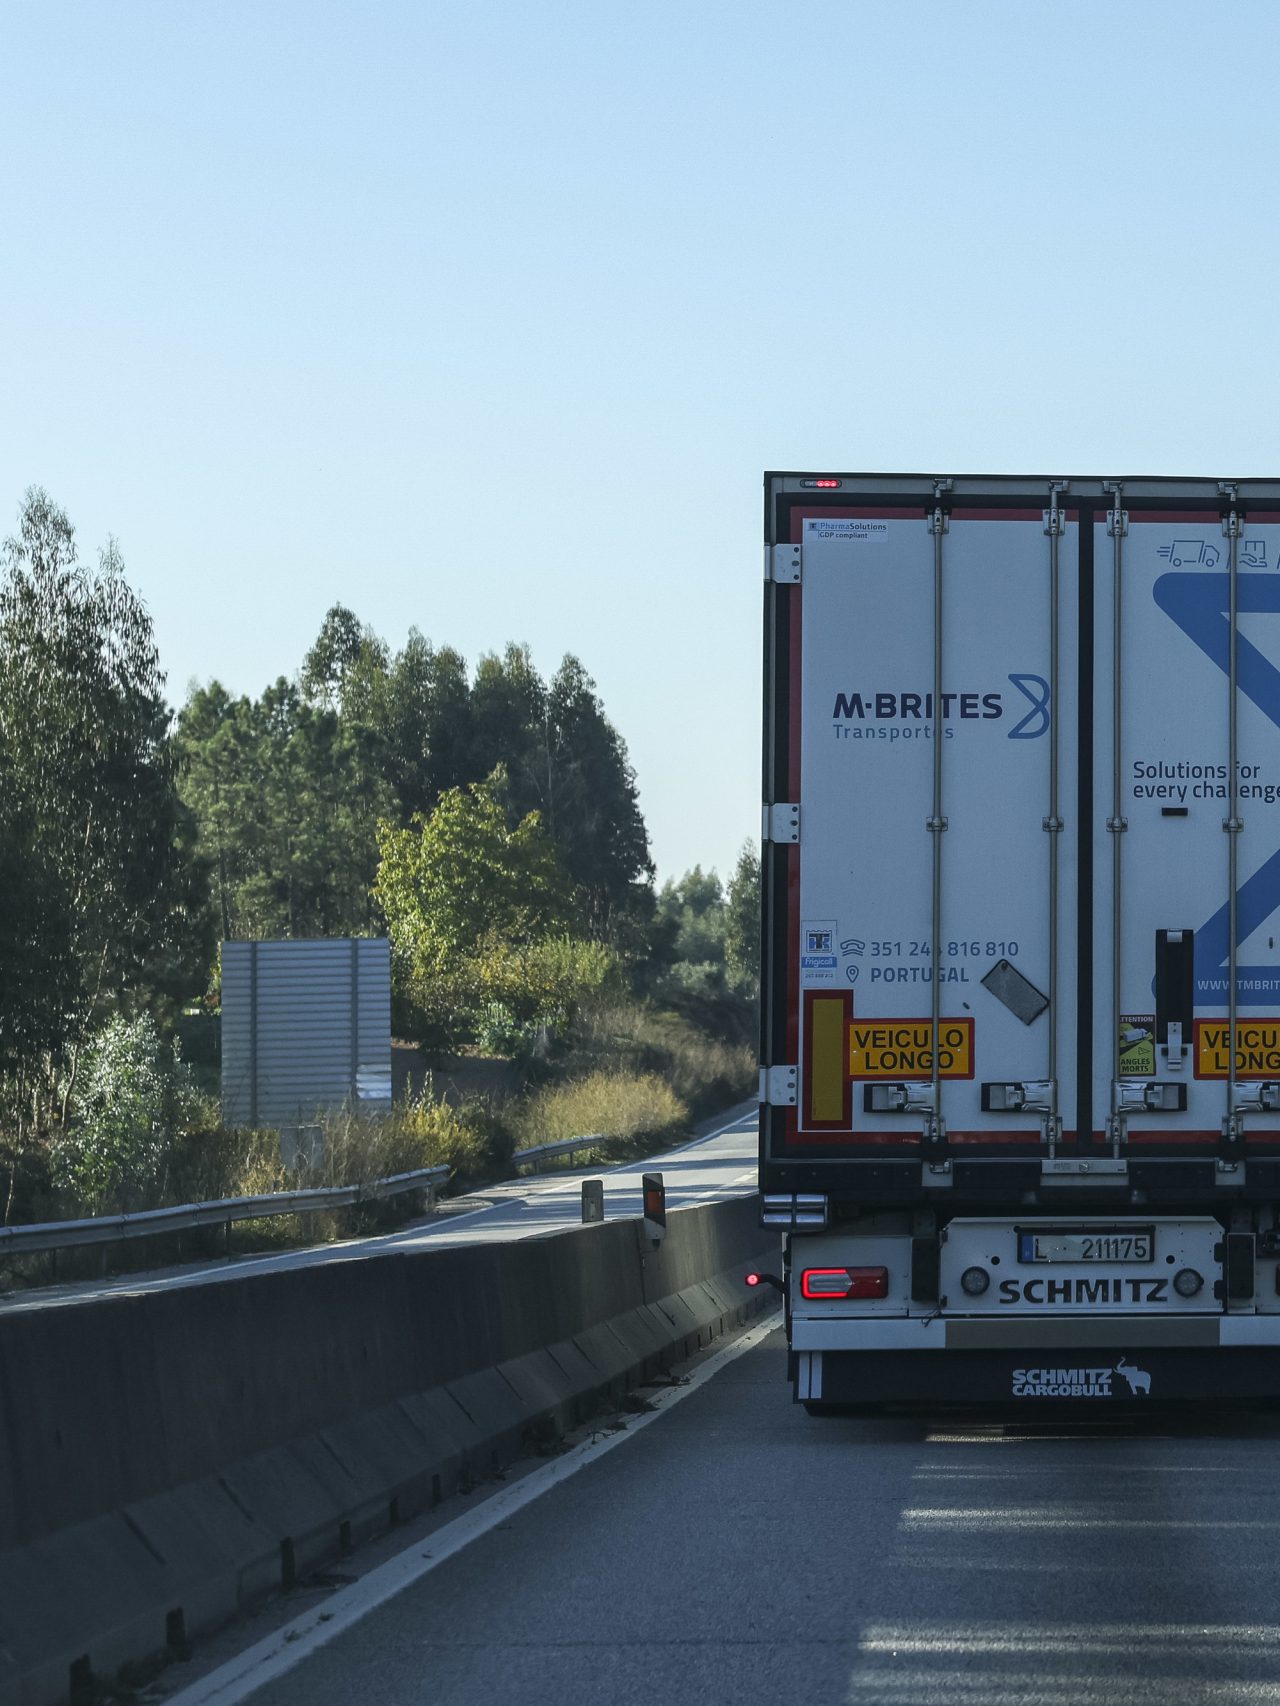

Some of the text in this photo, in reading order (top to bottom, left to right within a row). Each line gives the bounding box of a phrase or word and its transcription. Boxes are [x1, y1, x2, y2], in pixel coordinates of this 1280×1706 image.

[832, 724, 954, 742] Transports
[1133, 761, 1227, 779] Solutions
[1133, 784, 1187, 803] every
[870, 941, 1019, 957] 351 24 816 810
[870, 967, 969, 983] PORTUGAL
[865, 1051, 954, 1070] LONGO
[1120, 1058, 1151, 1066] ANGLES
[1081, 1238, 1147, 1259] 211175
[999, 1278, 1168, 1304] SCHMITZ
[1012, 1368, 1112, 1384] SCHMITZ
[1012, 1384, 1112, 1396] CARGOBULL
